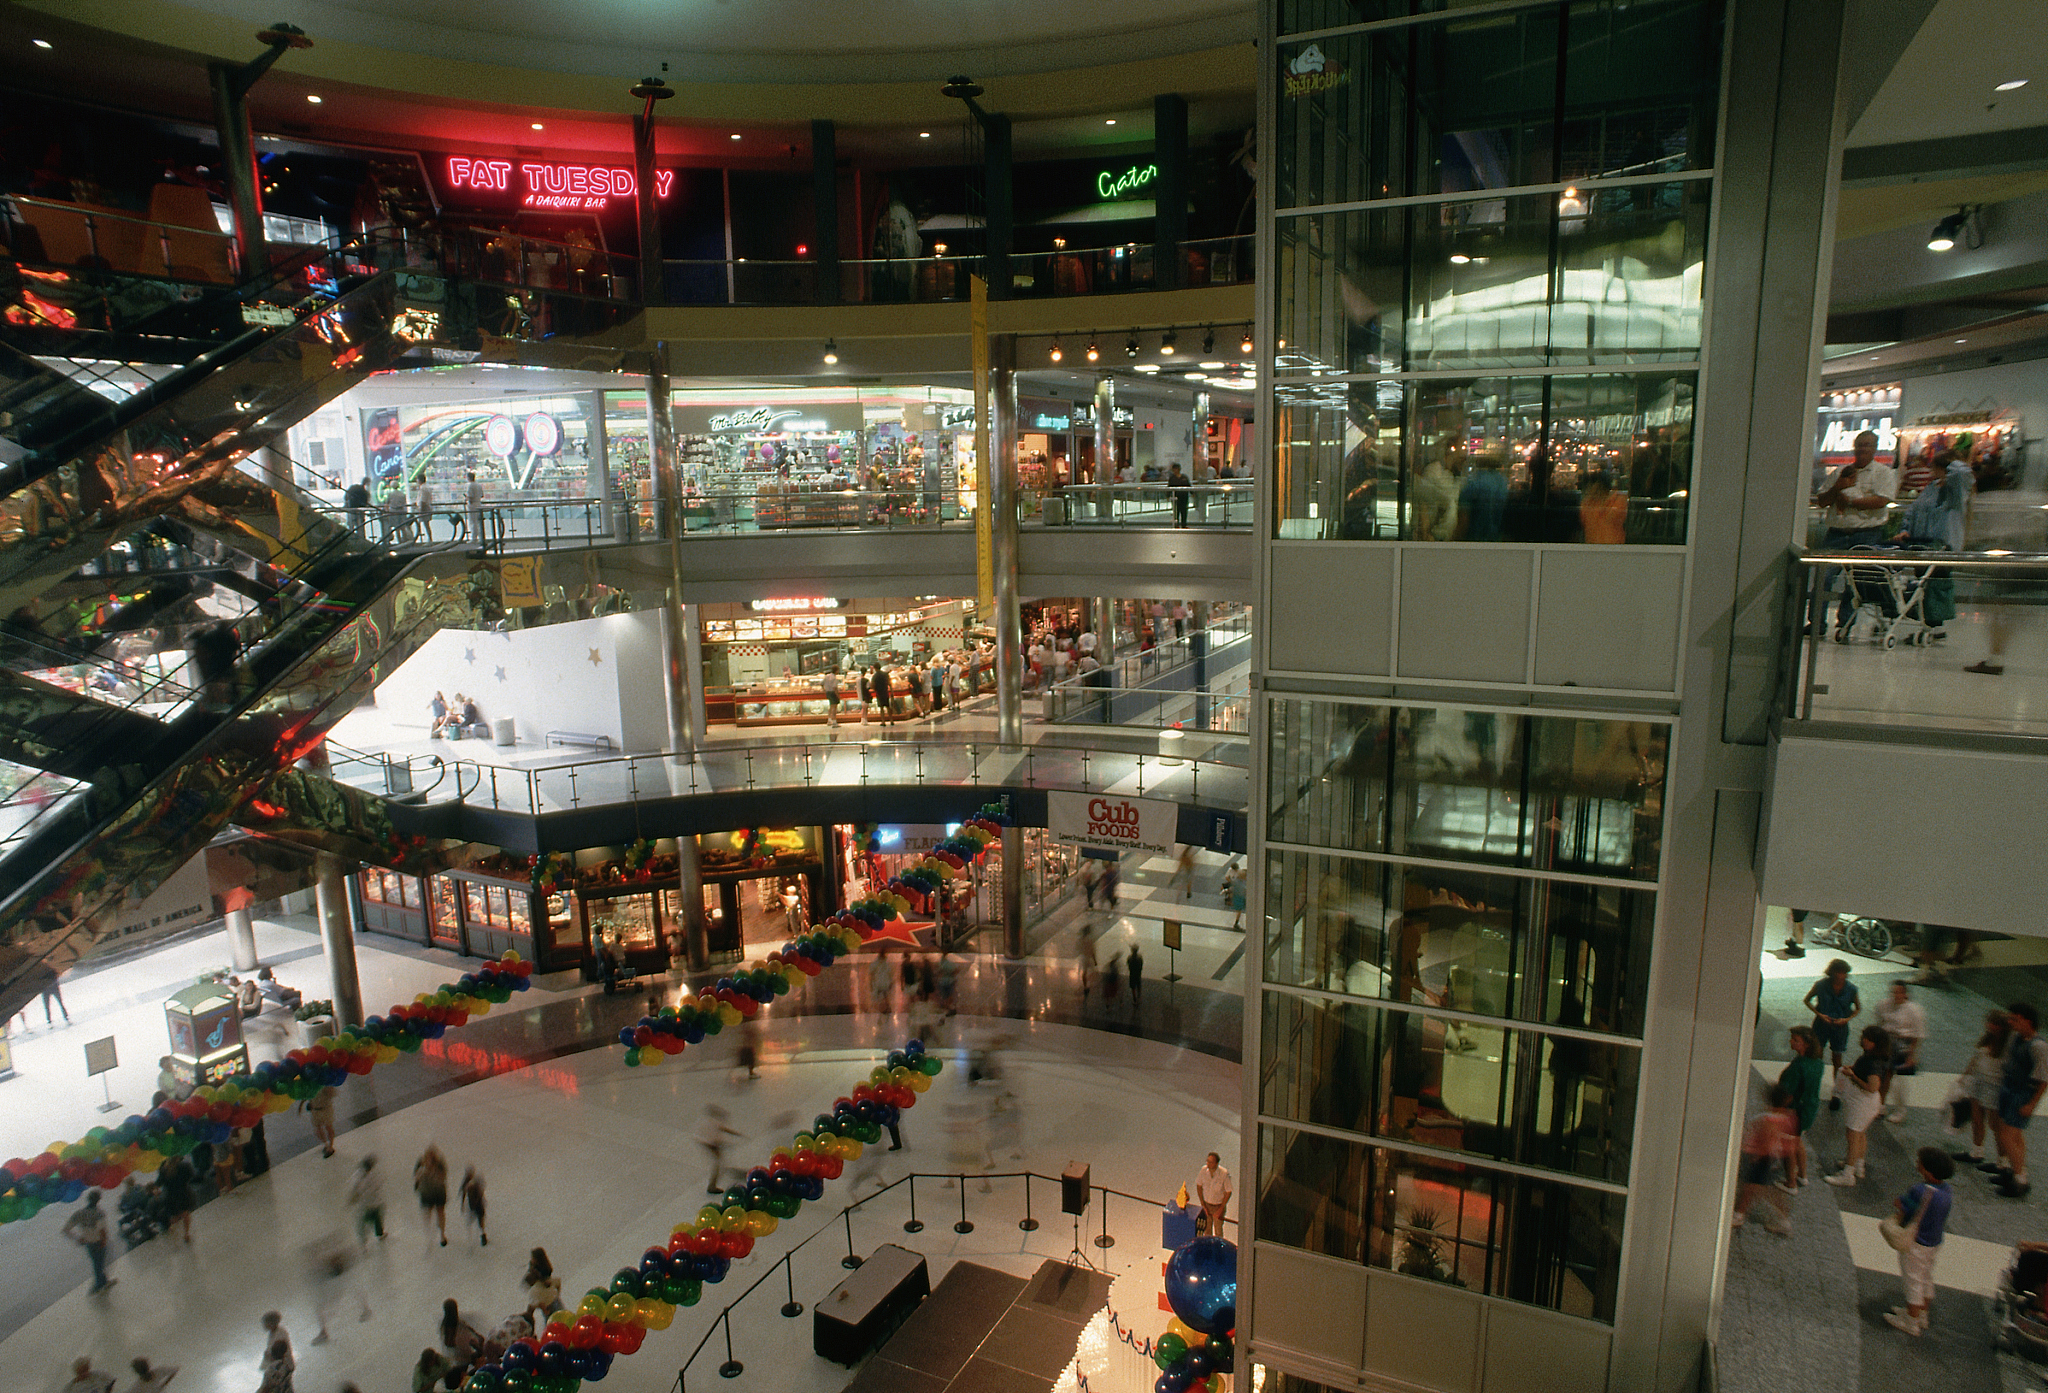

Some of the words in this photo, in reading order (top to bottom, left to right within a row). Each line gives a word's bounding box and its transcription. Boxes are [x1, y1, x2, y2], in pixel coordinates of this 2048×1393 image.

[449, 157, 511, 190] FAT
[522, 163, 673, 197] TUESDY
[525, 194, 535, 205] A
[536, 195, 581, 208] DAIQUIRI
[584, 197, 607, 209] BAR
[1088, 798, 1139, 825] Cub
[1087, 821, 1140, 840] FOODS
[123, 922, 148, 935] MALL
[150, 916, 160, 928] OF
[165, 904, 202, 923] AMERICA
